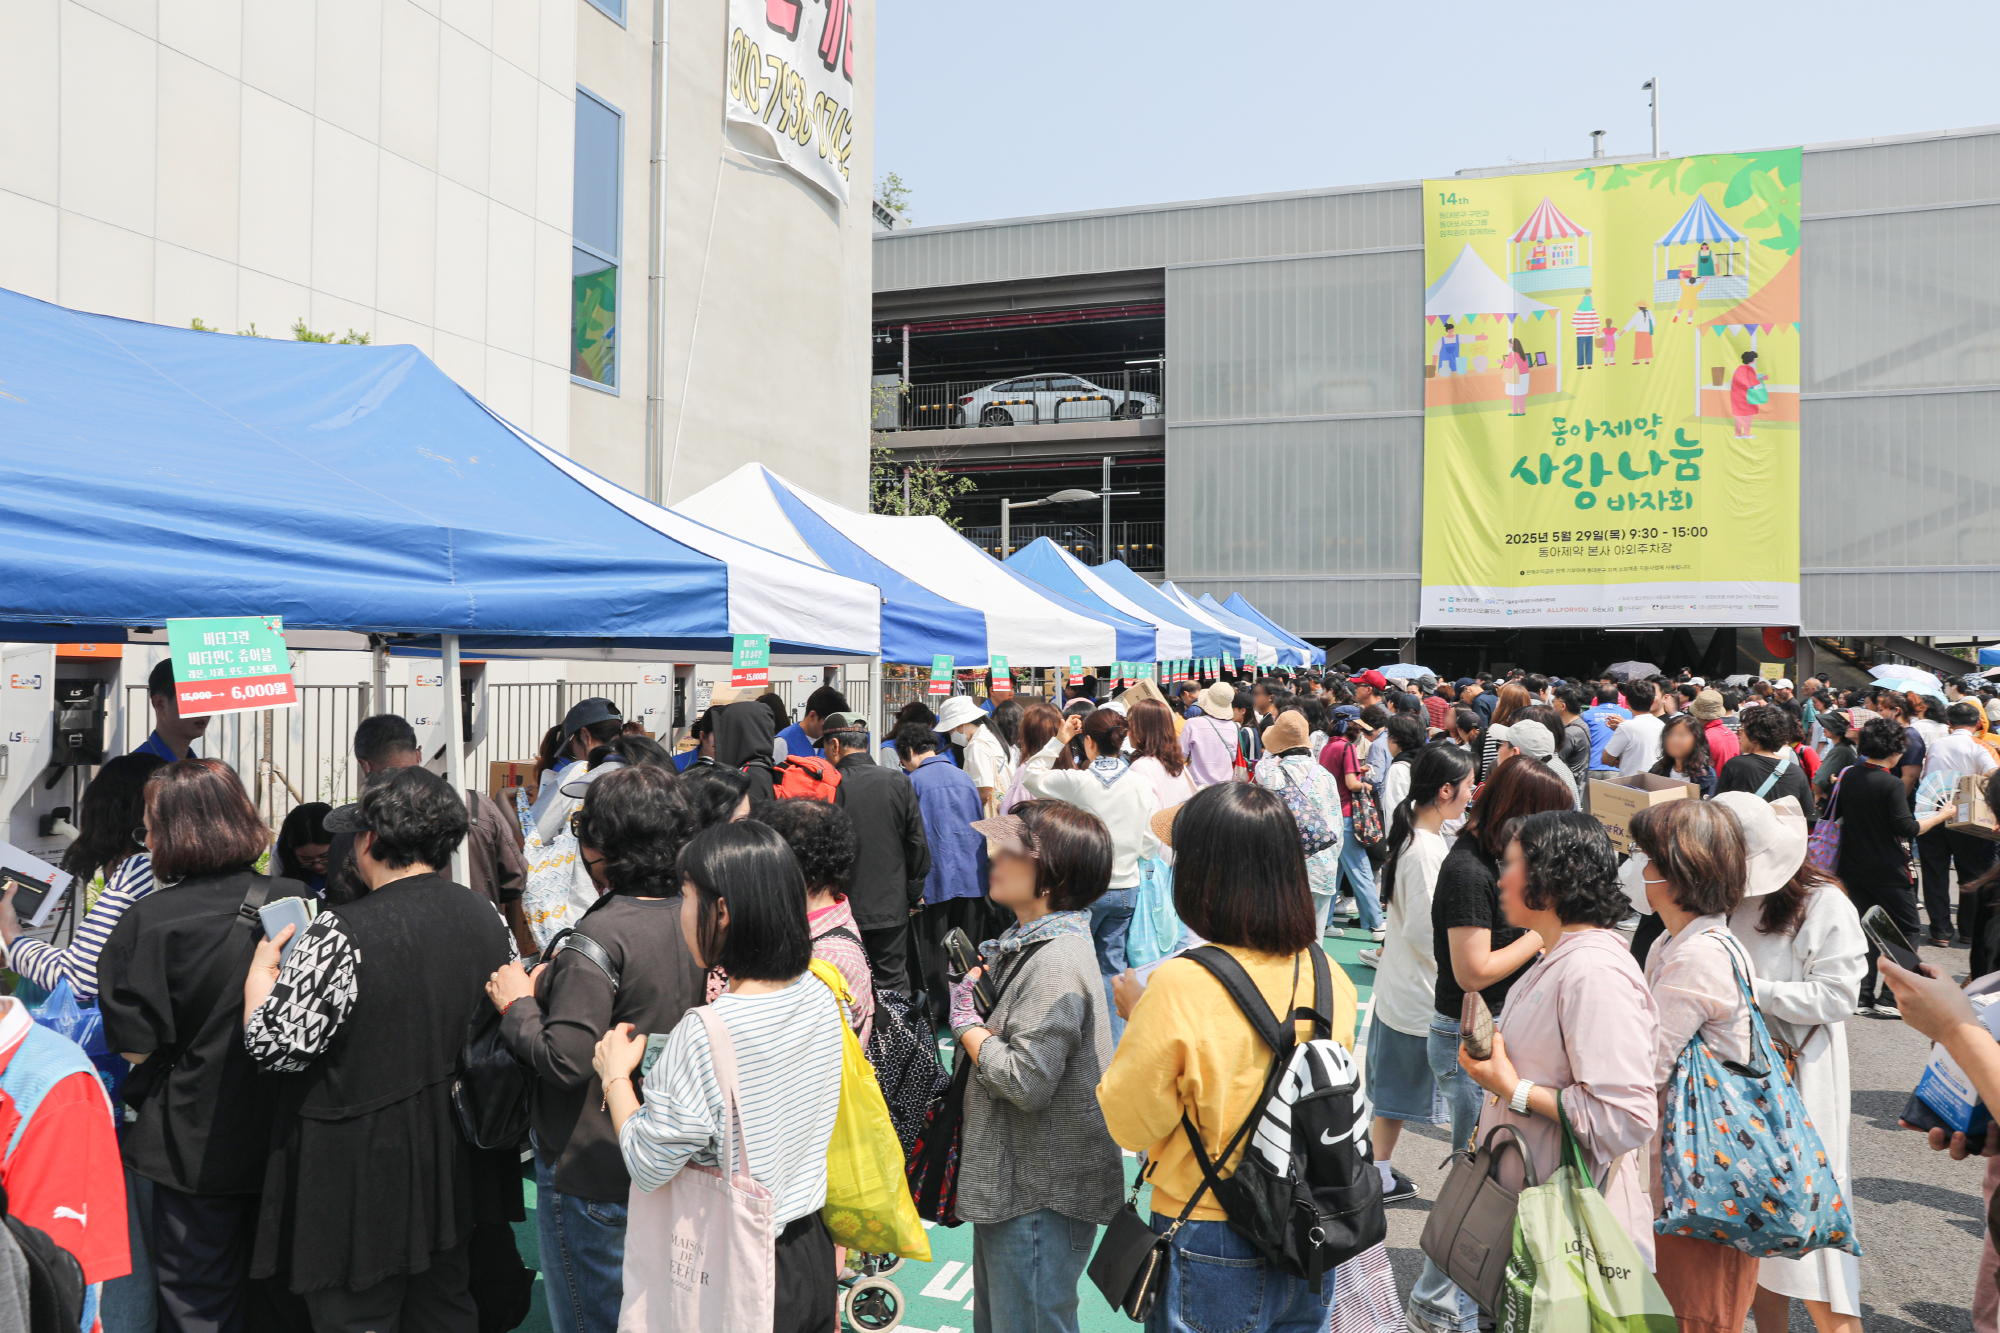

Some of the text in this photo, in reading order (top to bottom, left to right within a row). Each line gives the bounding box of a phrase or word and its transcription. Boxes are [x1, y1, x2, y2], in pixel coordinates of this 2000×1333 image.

[1439, 193, 1469, 205] 14th
[1552, 413, 1663, 446] 동아제약
[1607, 486, 1693, 511] 바자회
[1505, 531, 1549, 545] 2025년
[1552, 531, 1572, 543] 5월
[1576, 529, 1626, 542] 29일(목)
[1630, 527, 1659, 540] 9:30
[1672, 526, 1708, 538] 15:00
[1538, 542, 1672, 558] 동아제약 본사 야외주차장
[203, 630, 250, 647] 비타그란
[188, 647, 272, 666] 비타민C 츄어블
[231, 682, 288, 700] 6,000원
[680, 1250, 695, 1265] DE
